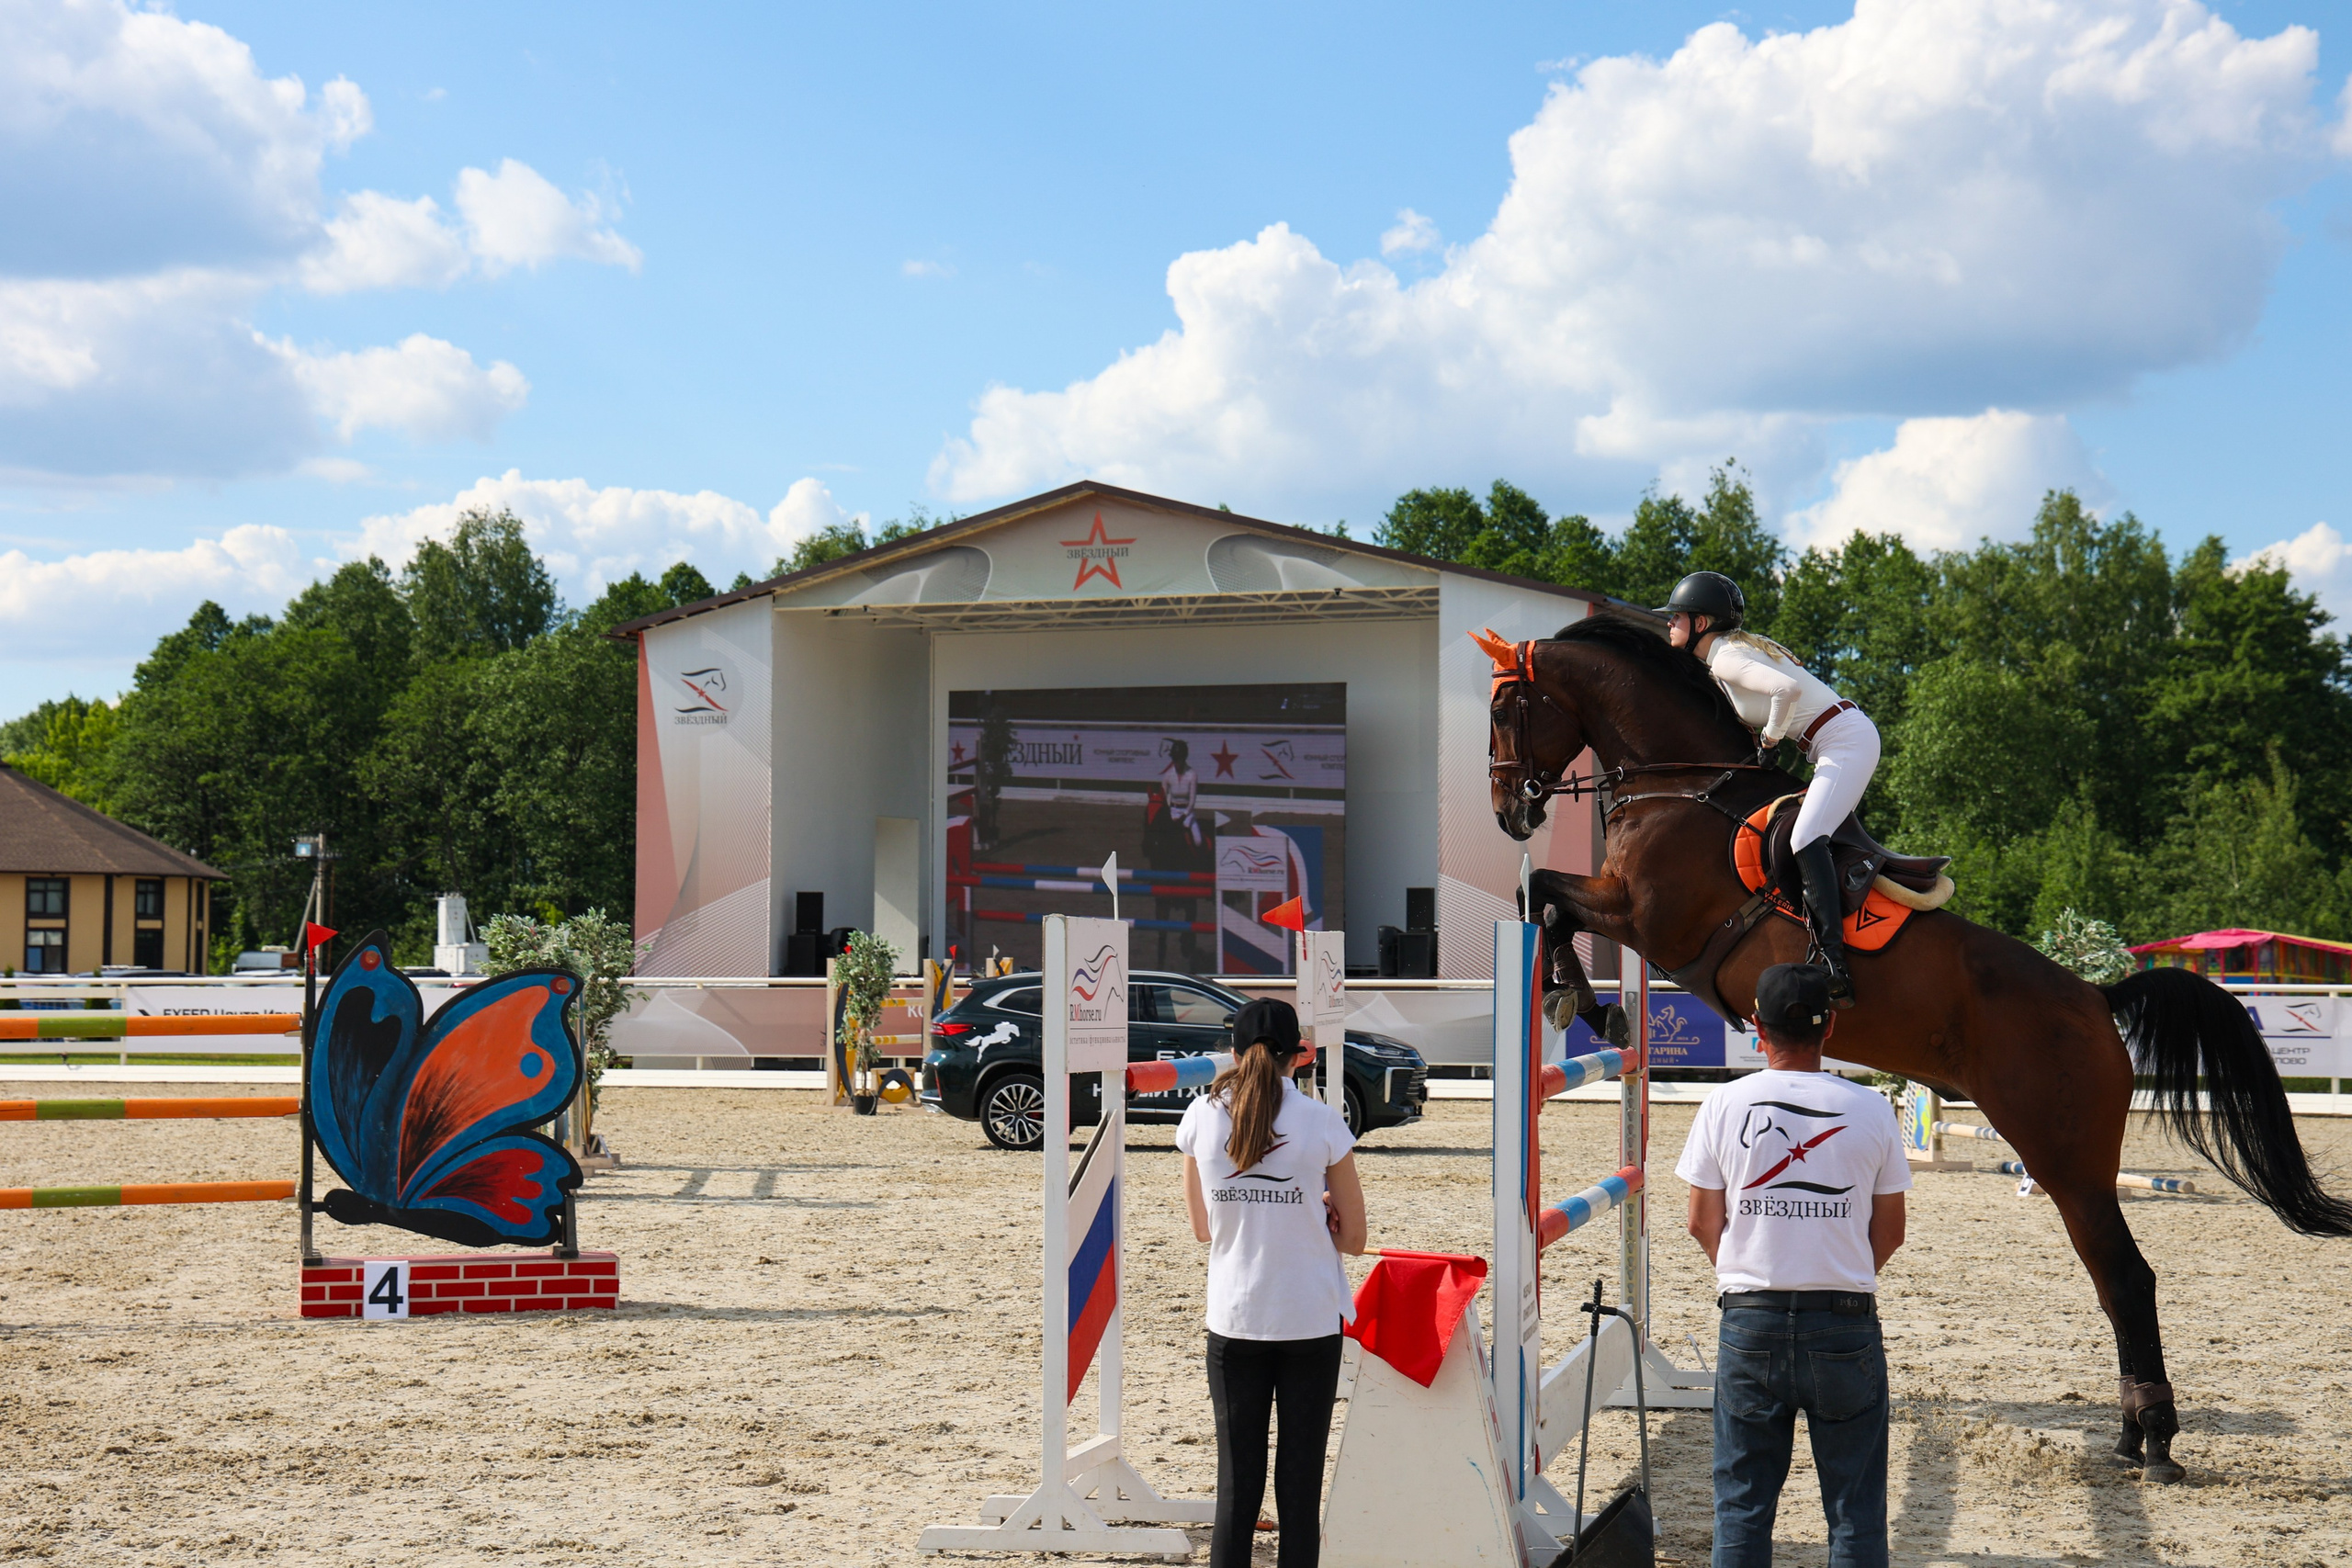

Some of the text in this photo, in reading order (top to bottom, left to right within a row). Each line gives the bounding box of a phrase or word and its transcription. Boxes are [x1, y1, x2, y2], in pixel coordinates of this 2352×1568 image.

[1764, 892, 1795, 912] VALERIE
[1211, 1187, 1304, 1204] ЗВЁЗДНЫЙ
[1739, 1196, 1851, 1220] ЗВЁЗДНЫЙ
[368, 1267, 403, 1314] 4
